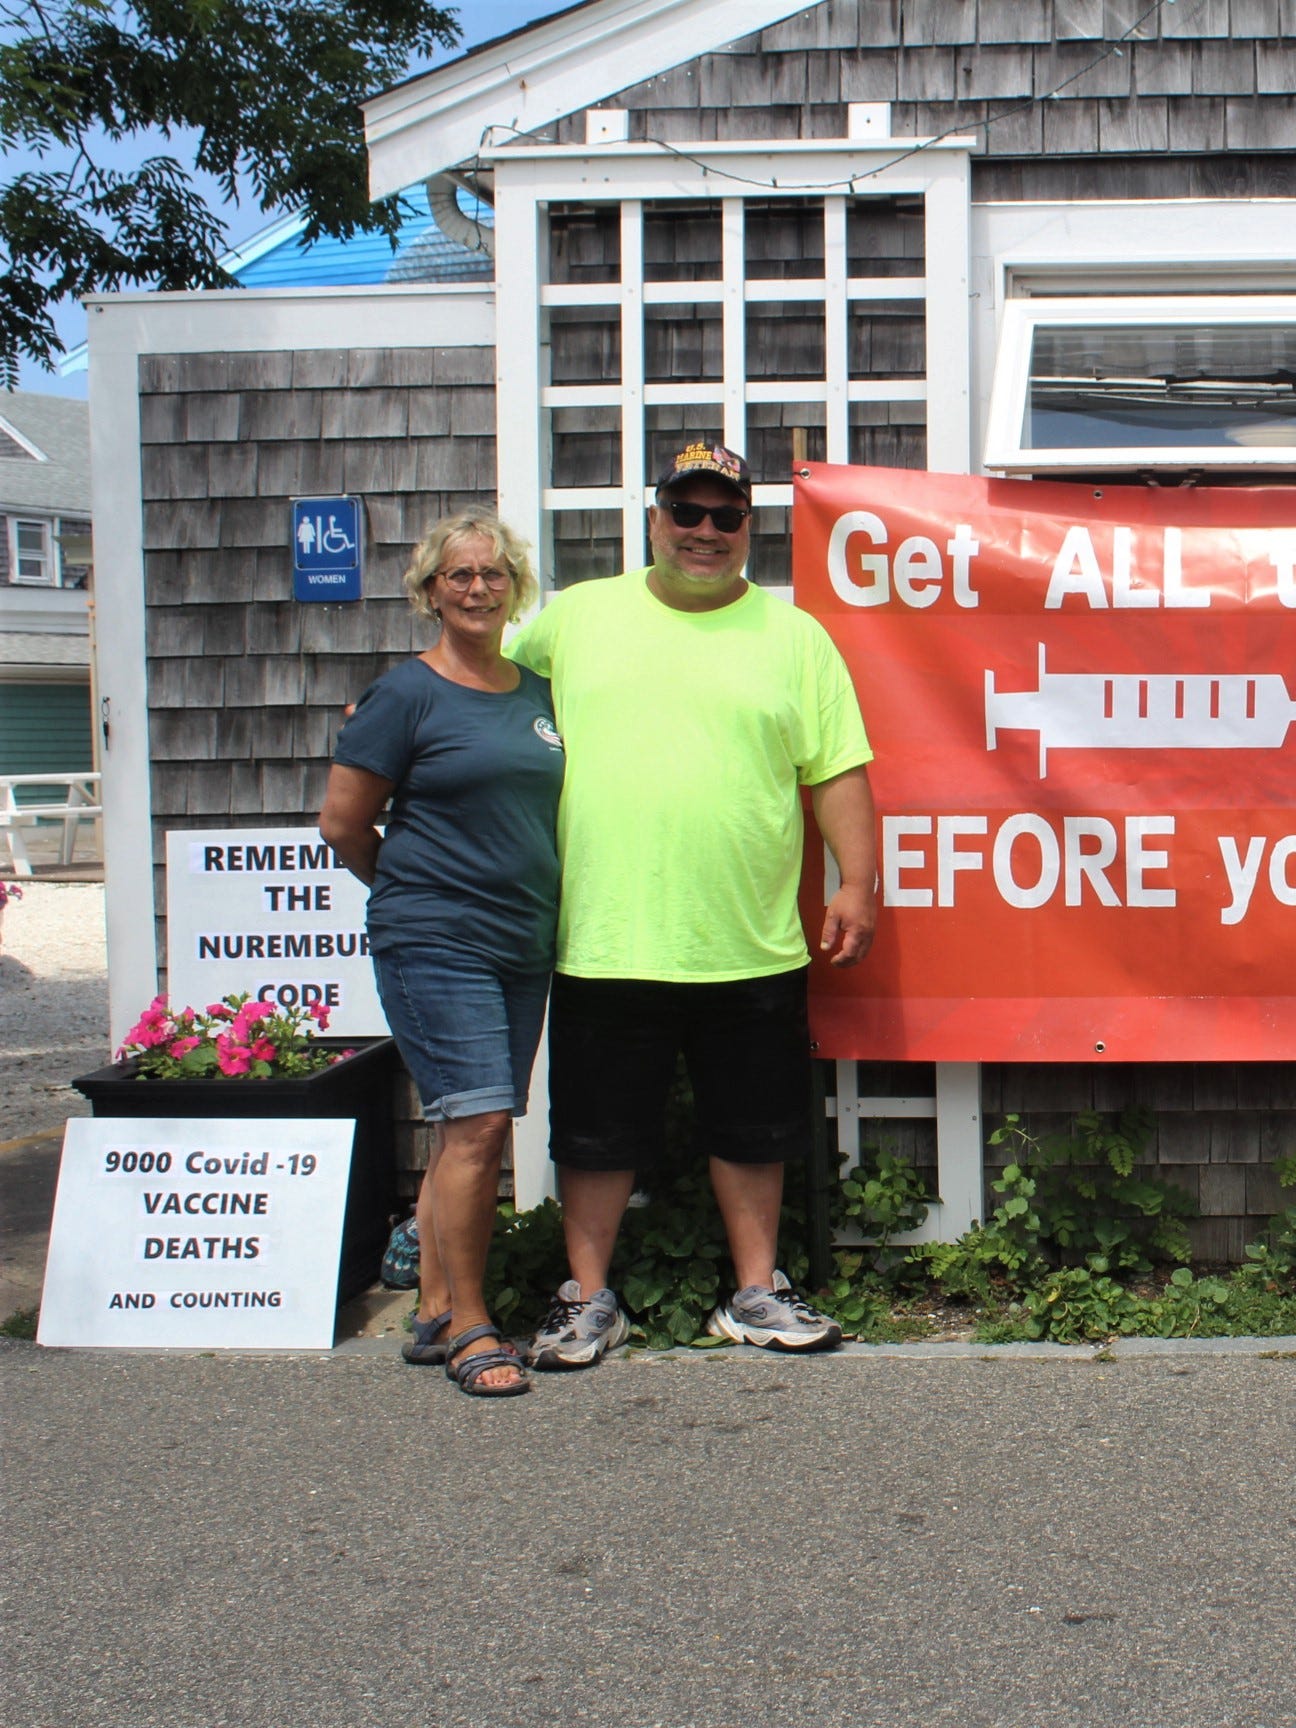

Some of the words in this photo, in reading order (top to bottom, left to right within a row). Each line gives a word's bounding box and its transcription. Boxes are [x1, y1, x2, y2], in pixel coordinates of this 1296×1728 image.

[828, 511, 979, 608] Get
[1045, 526, 1210, 609] ALL
[308, 575, 346, 584] WOMEN
[824, 813, 1176, 908] EFORE
[264, 886, 331, 911] THE
[257, 984, 340, 1007] CODE
[105, 1151, 172, 1173] 9000
[185, 1151, 270, 1175] Covid
[143, 1192, 269, 1215] VACCINE
[143, 1236, 260, 1260] DEATHS
[109, 1293, 156, 1309] AND
[170, 1291, 282, 1308] COUNTING
